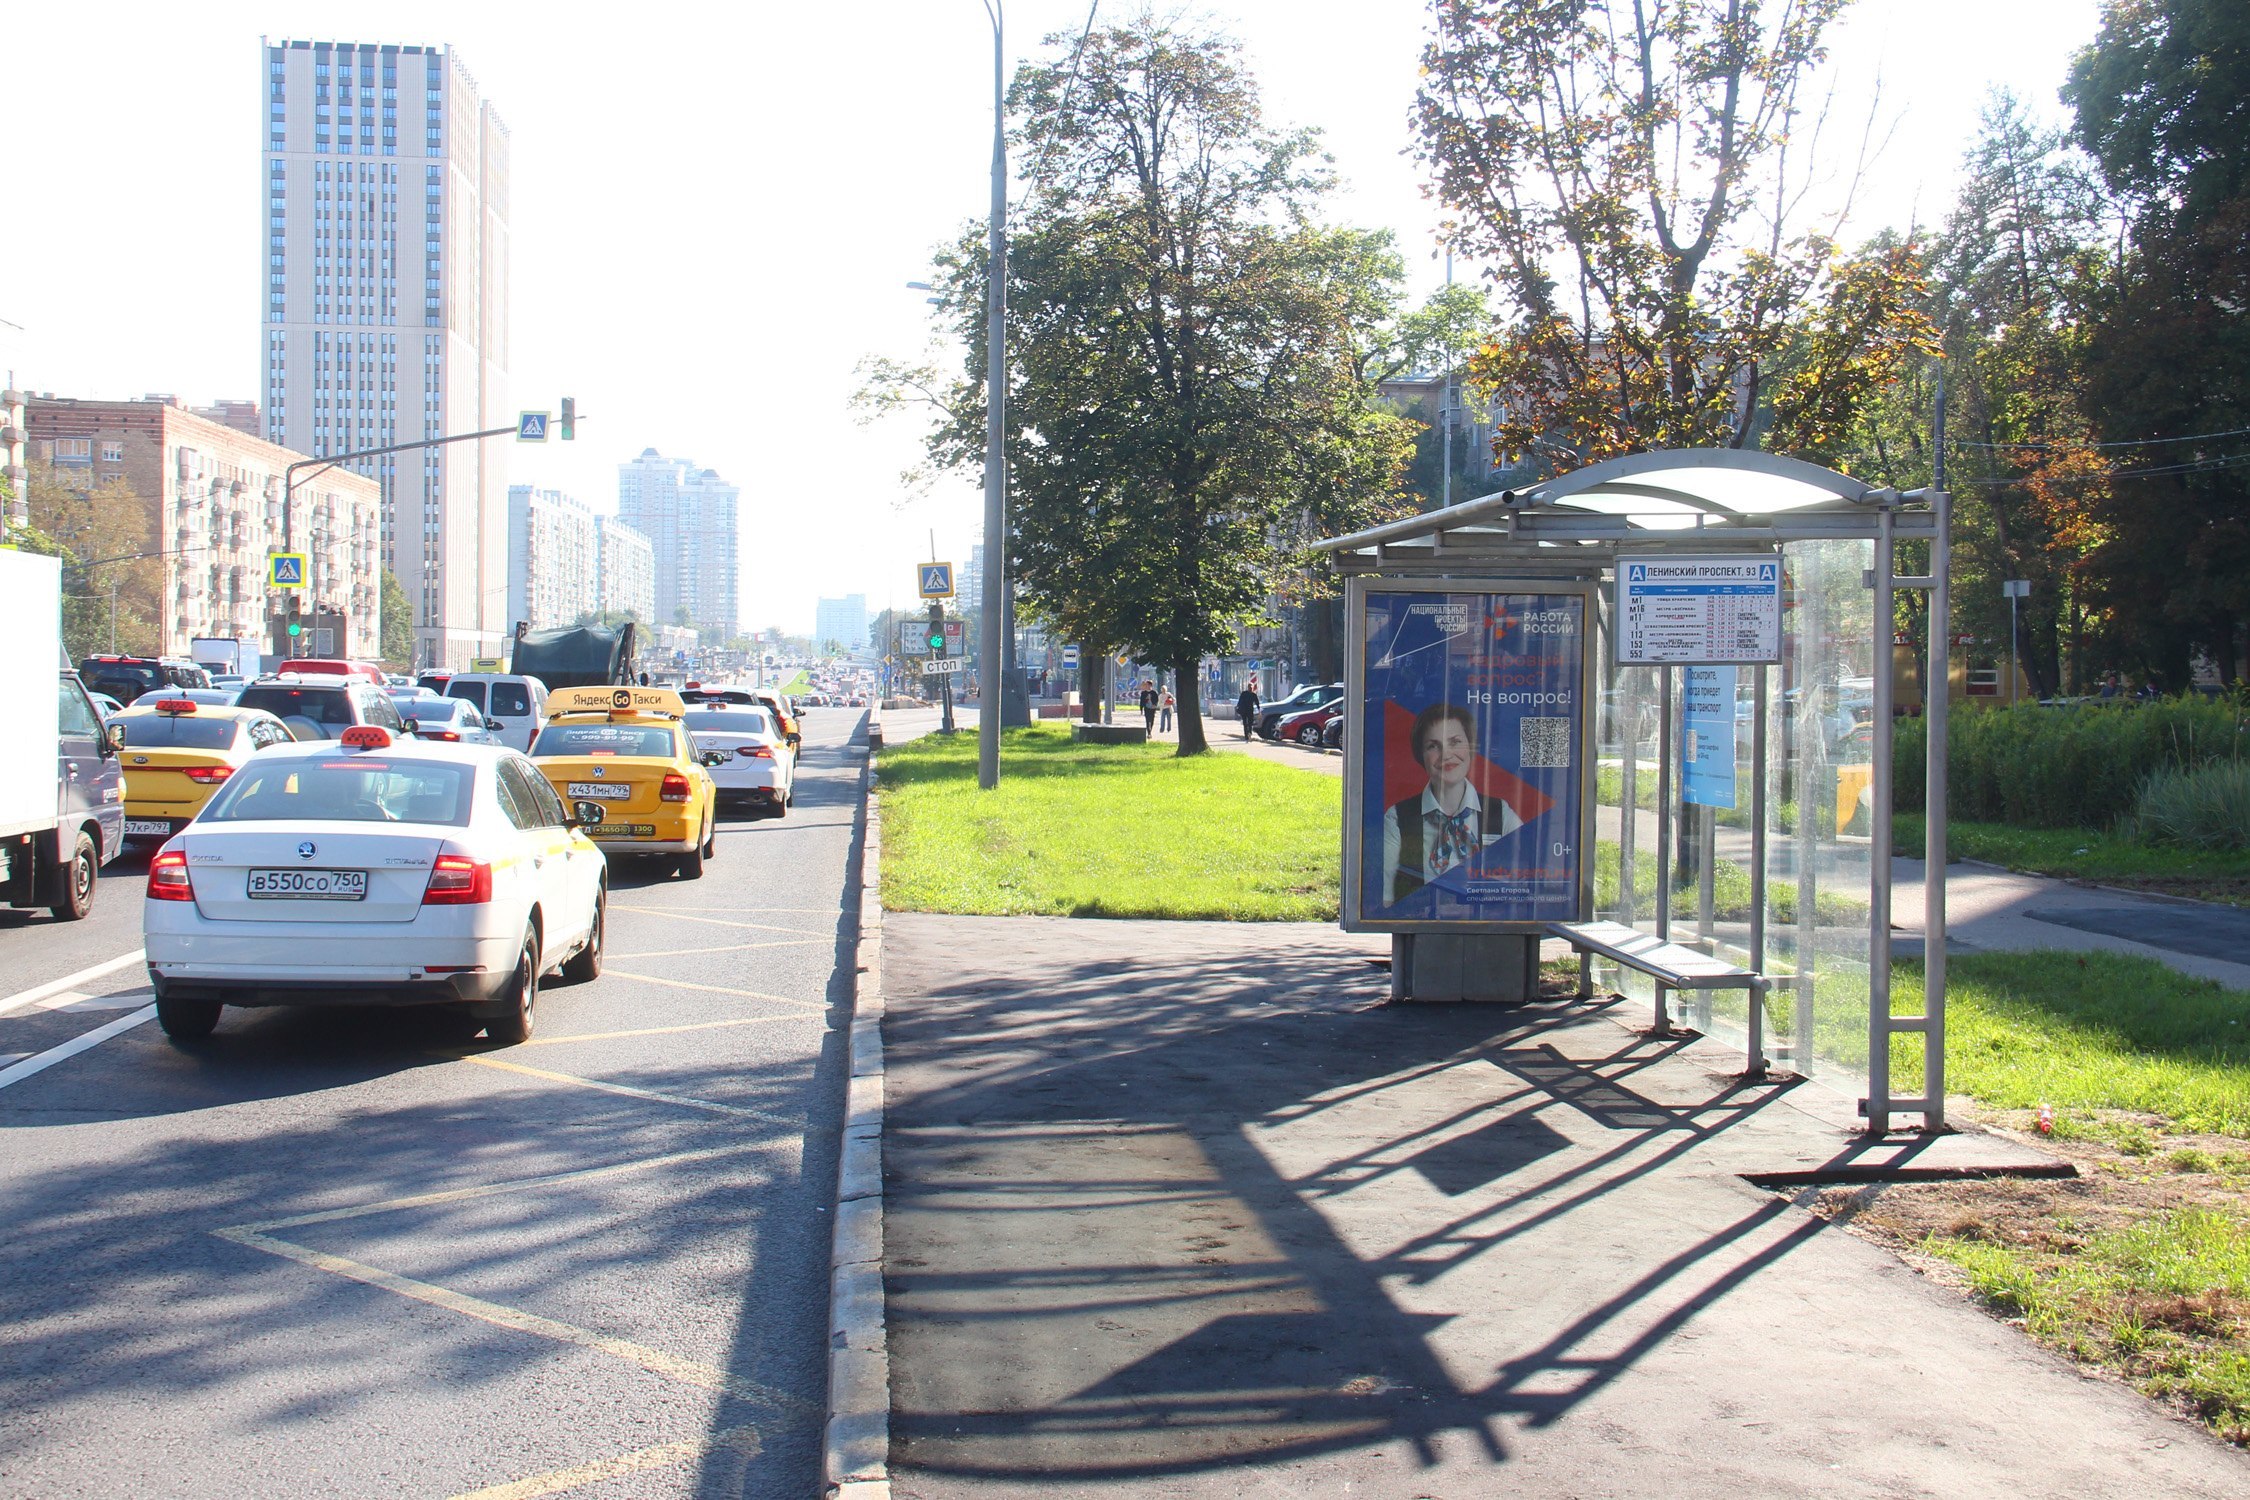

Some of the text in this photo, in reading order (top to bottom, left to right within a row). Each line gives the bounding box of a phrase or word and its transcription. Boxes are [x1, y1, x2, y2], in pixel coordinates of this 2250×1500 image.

[1647, 565, 1697, 577] ЛЕНИНСКИЙ
[1699, 566, 1744, 578] ПРОСПЕКТ,
[1746, 566, 1756, 577] 93
[1411, 606, 1466, 615] НАЦИОНАЛЬНЫЕ
[1435, 615, 1466, 623] ПРОЕКТЫ
[1523, 612, 1572, 623] РАБОТА
[1440, 623, 1466, 632] РОССИИ
[1523, 624, 1574, 634] РОССИИ
[1631, 631, 1643, 639] 113
[1631, 640, 1643, 649] 153
[1630, 650, 1643, 658] 553
[927, 661, 957, 672] СТОП
[1467, 671, 1548, 688] вопрос?
[574, 691, 662, 707] Яндекс Go Такси
[1467, 689, 1572, 707] Не вопрос!
[1553, 842, 1572, 857] 0+
[254, 873, 361, 891] В550СО 750
